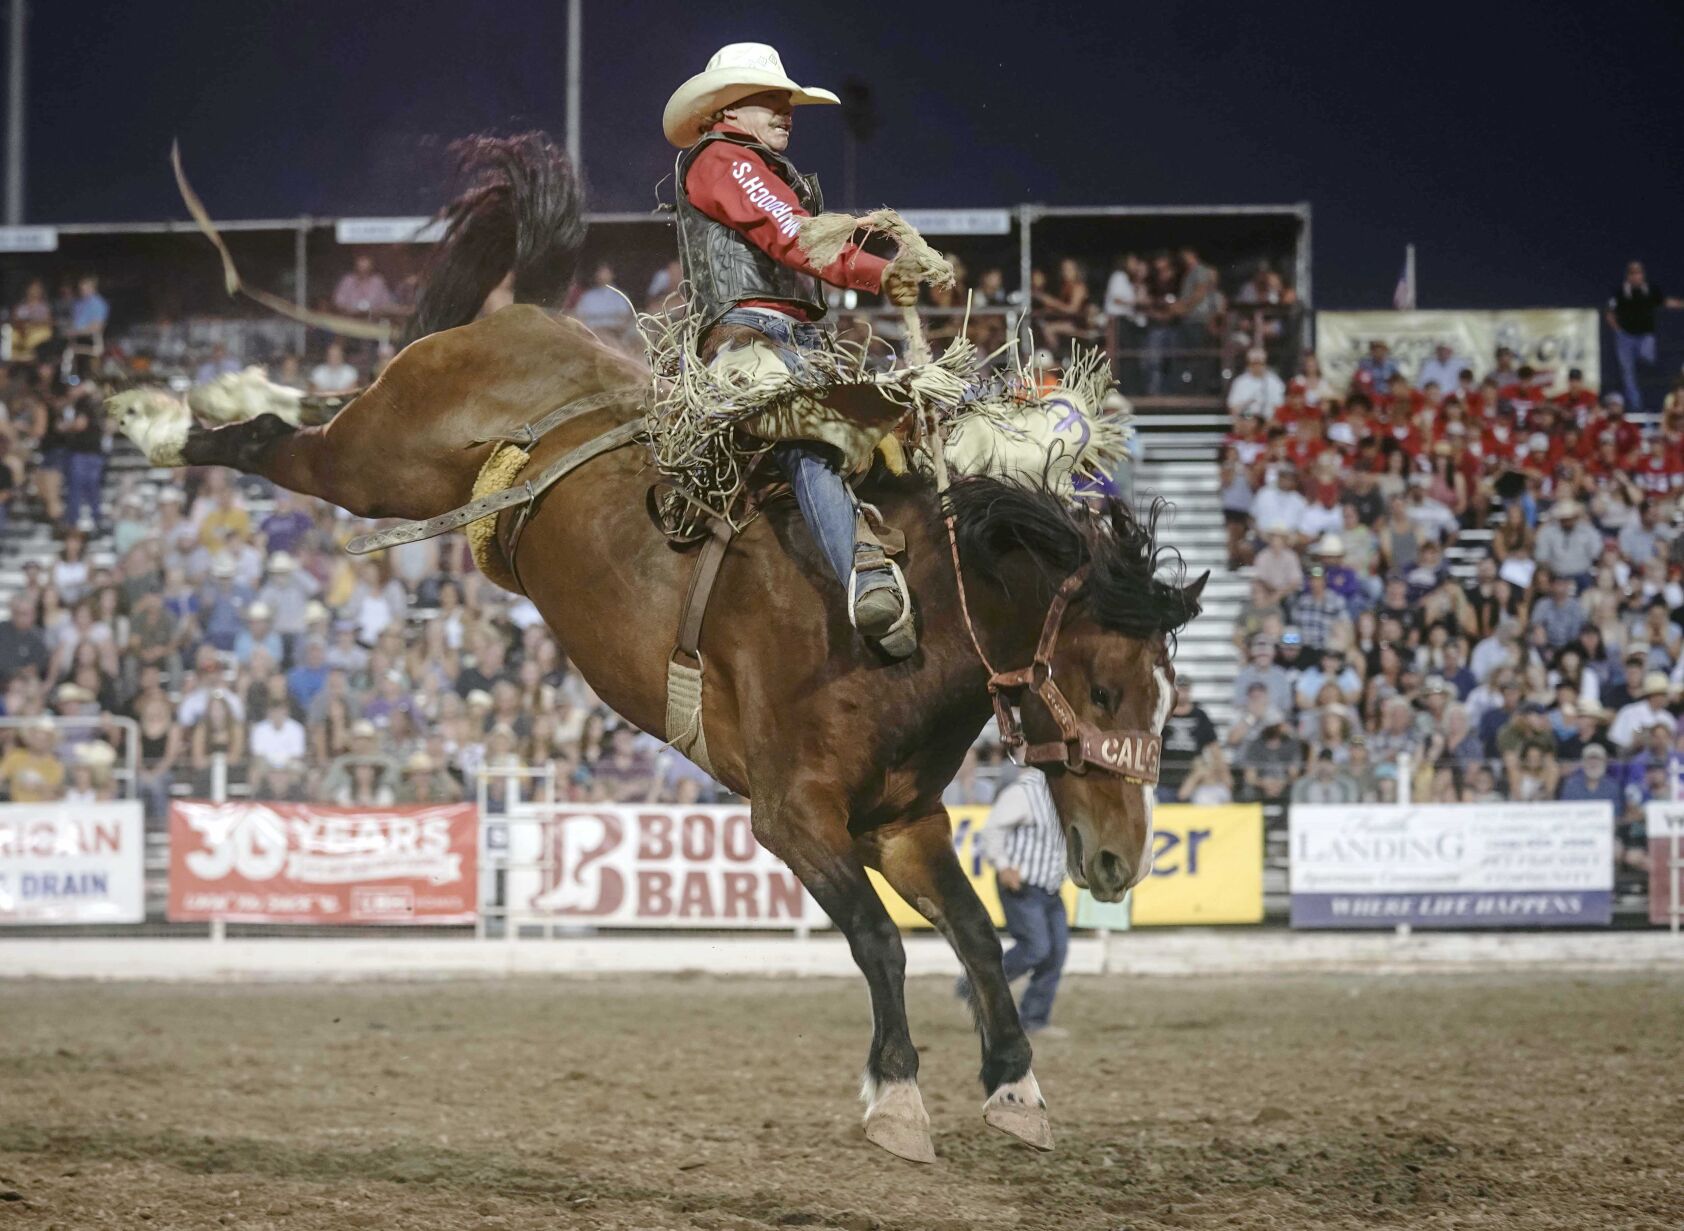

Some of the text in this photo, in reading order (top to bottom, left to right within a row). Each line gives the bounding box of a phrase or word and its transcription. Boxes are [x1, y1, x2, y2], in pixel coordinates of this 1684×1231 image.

[732, 160, 801, 238] MURDOCH'S
[185, 808, 452, 881] 30 YEARS
[637, 813, 758, 862] BOO
[1299, 831, 1466, 864] LANDING
[21, 871, 108, 899] DRAIN
[636, 871, 804, 919] BARN
[1331, 896, 1582, 916] WHERE LIFE HAPPENS
